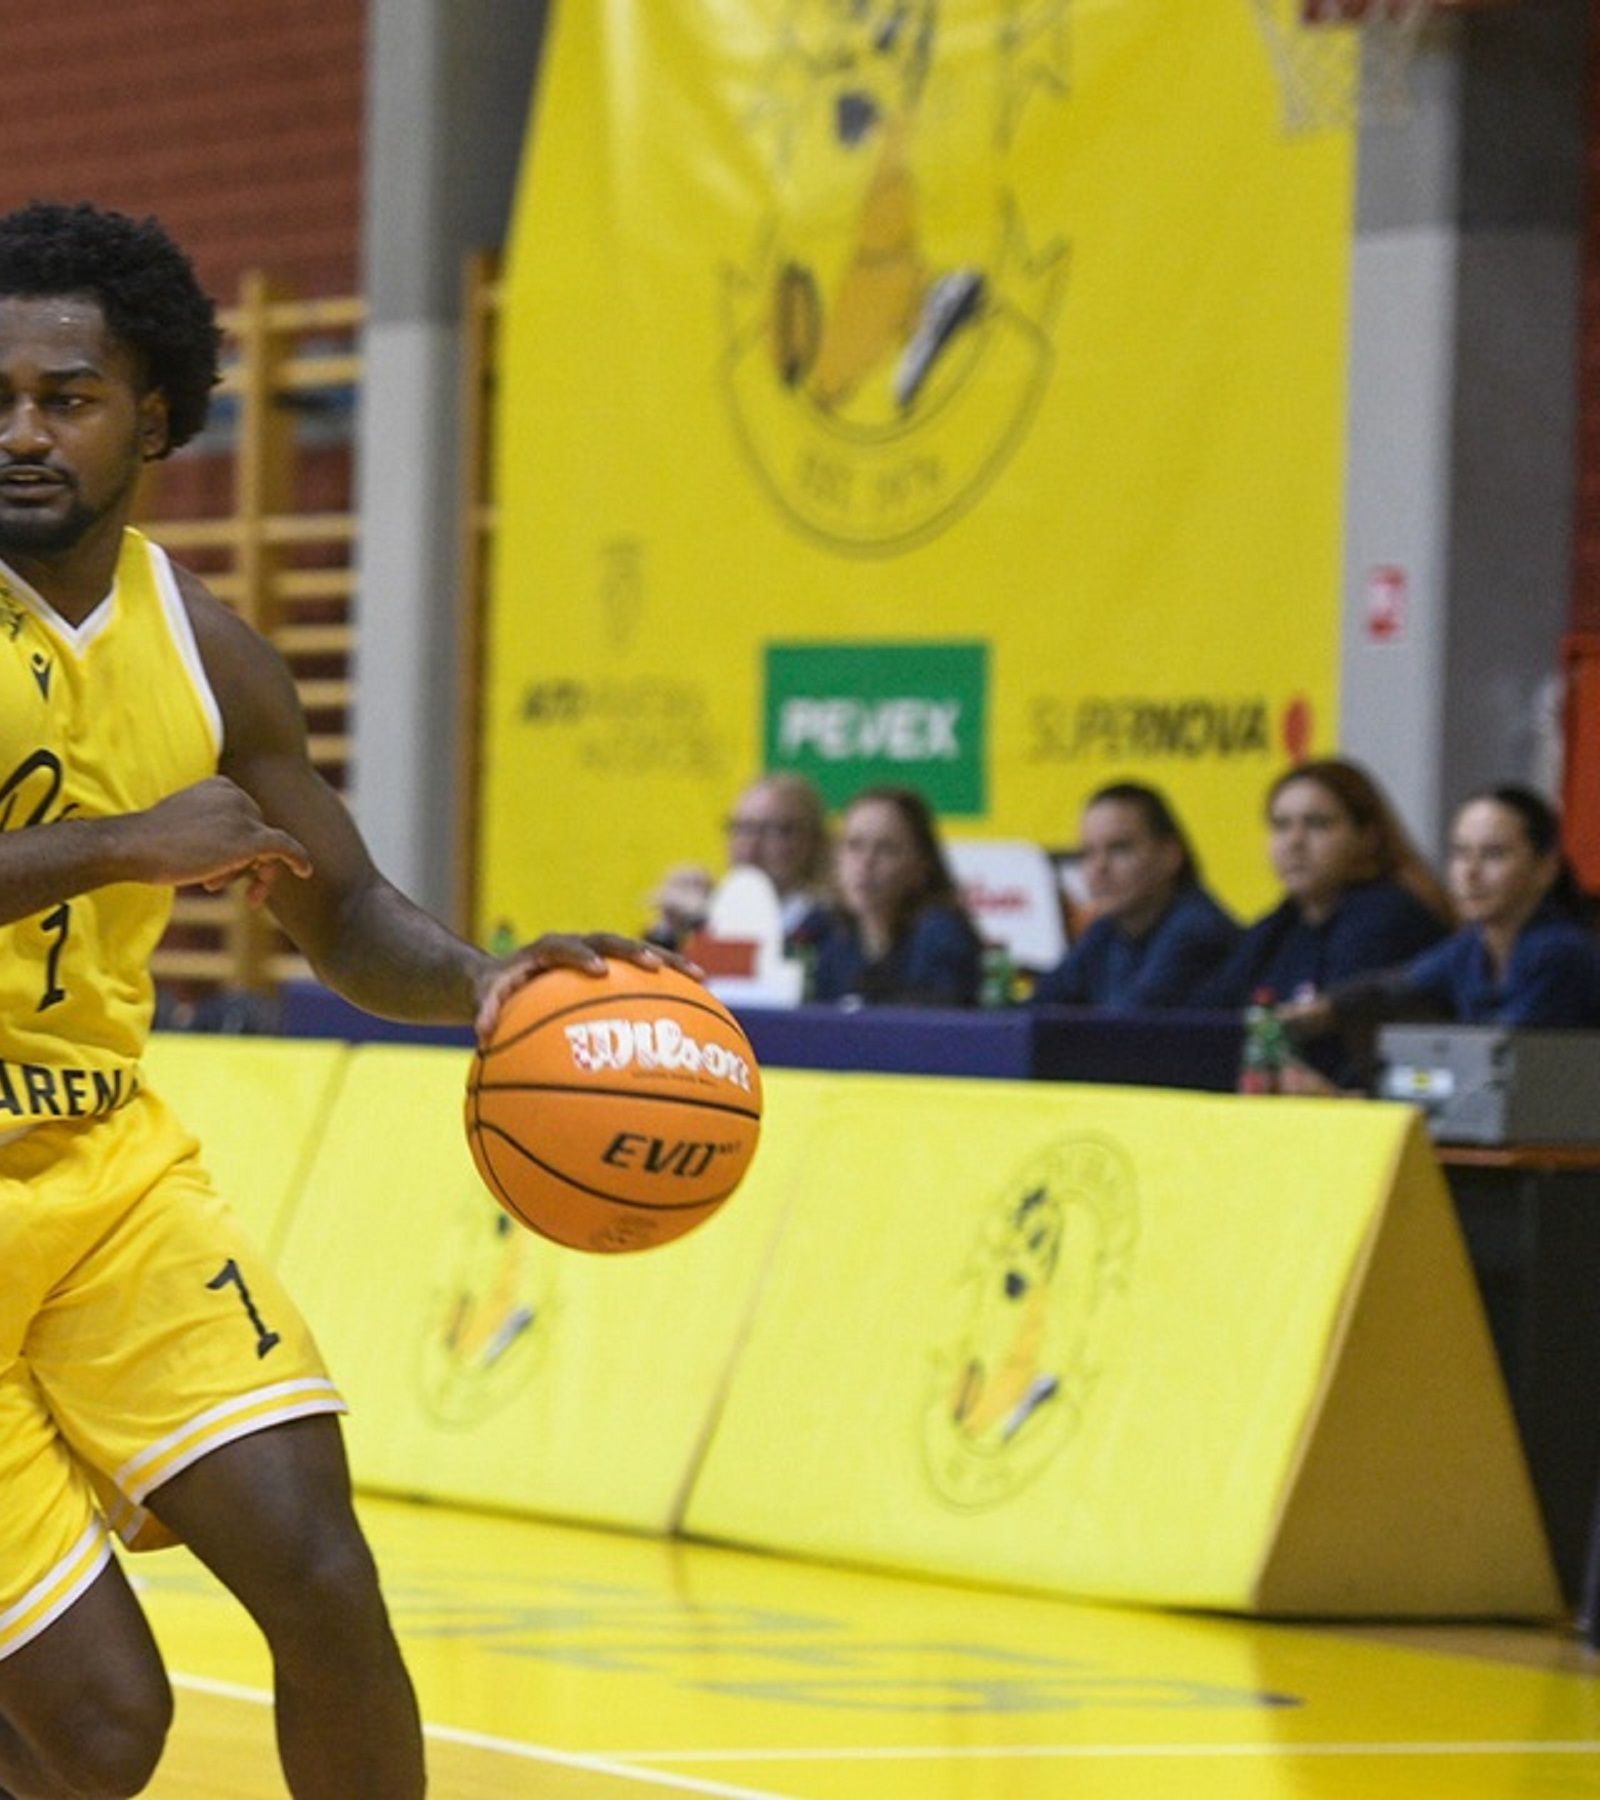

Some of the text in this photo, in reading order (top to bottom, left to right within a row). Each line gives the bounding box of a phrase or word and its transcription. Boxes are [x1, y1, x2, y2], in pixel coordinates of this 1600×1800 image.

[780, 697, 960, 760] PEVEX
[1026, 695, 1269, 763] SUPERNOVA
[37, 900, 70, 1012] 1
[564, 1018, 750, 1092] Wilson
[602, 1131, 717, 1179] EVO
[205, 1258, 280, 1360] 1
